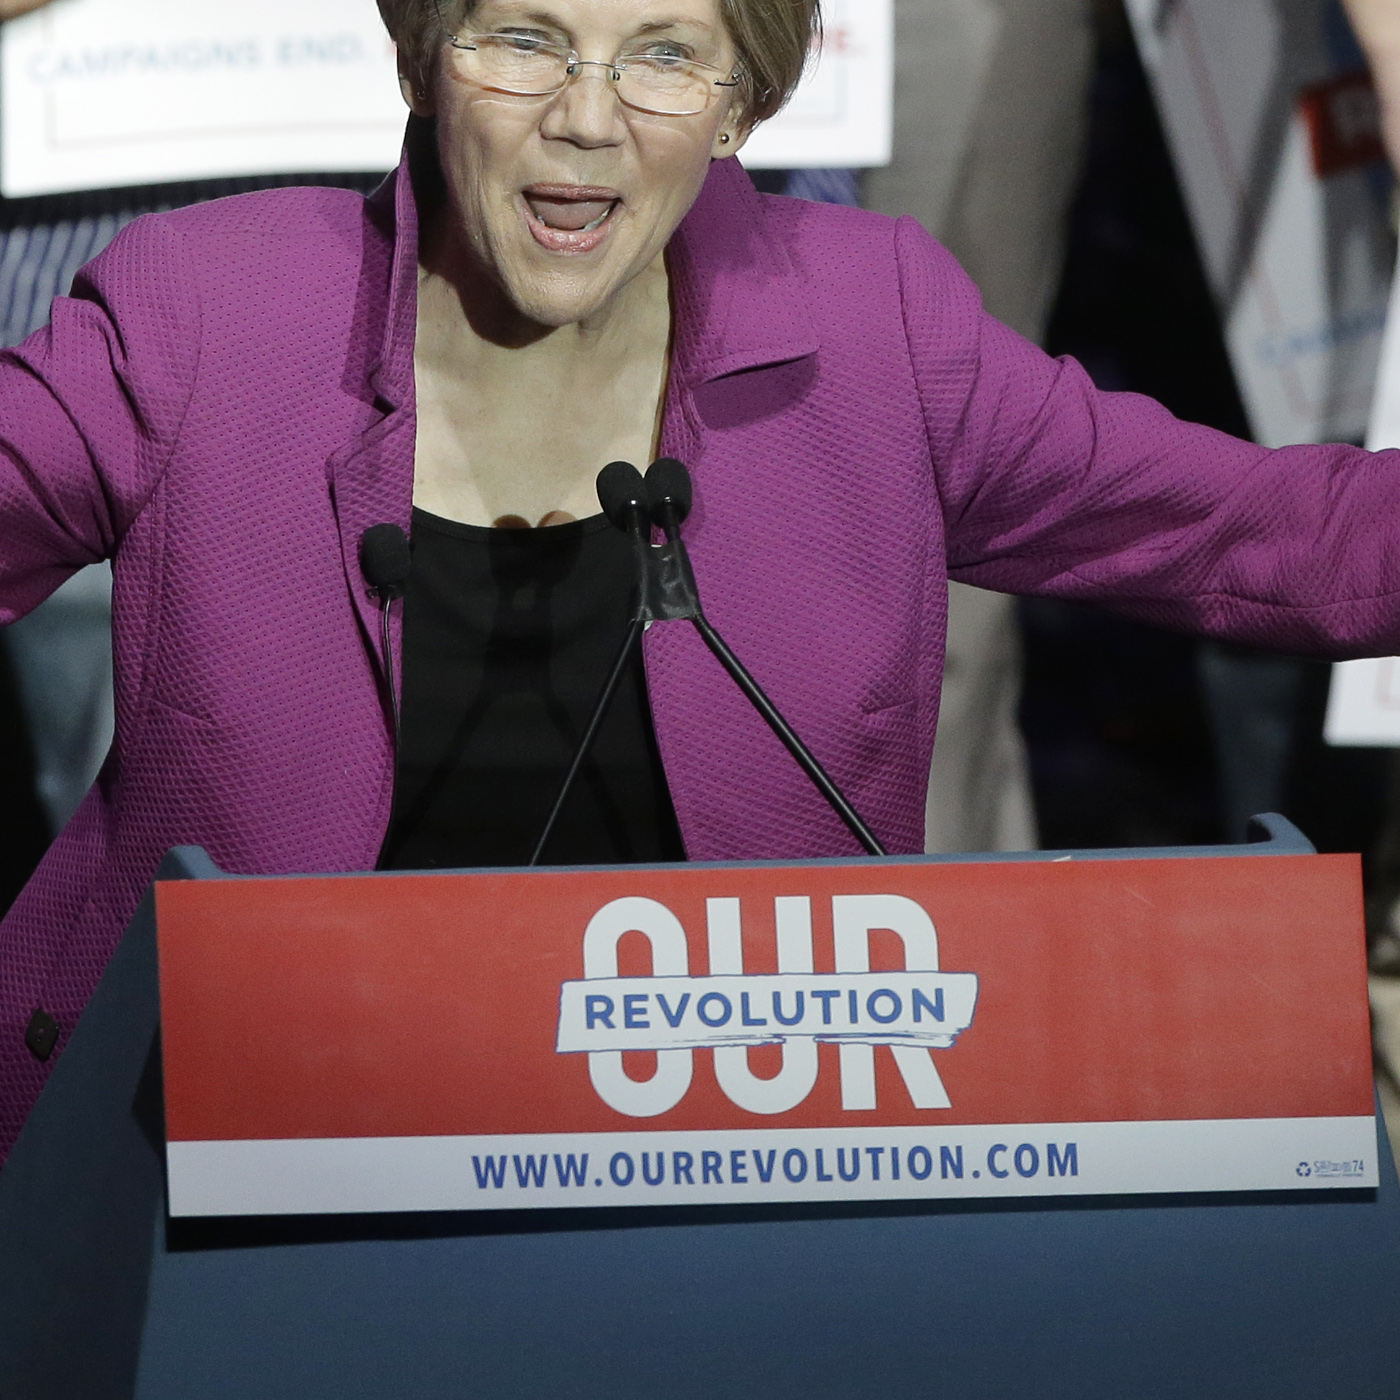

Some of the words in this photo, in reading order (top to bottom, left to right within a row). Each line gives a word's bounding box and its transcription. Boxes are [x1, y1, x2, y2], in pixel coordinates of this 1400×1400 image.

[582, 893, 953, 1118] OUR
[584, 987, 945, 1030] REVOLUTION
[471, 1142, 1080, 1189] WWW.OURREVOLUTION.COM
